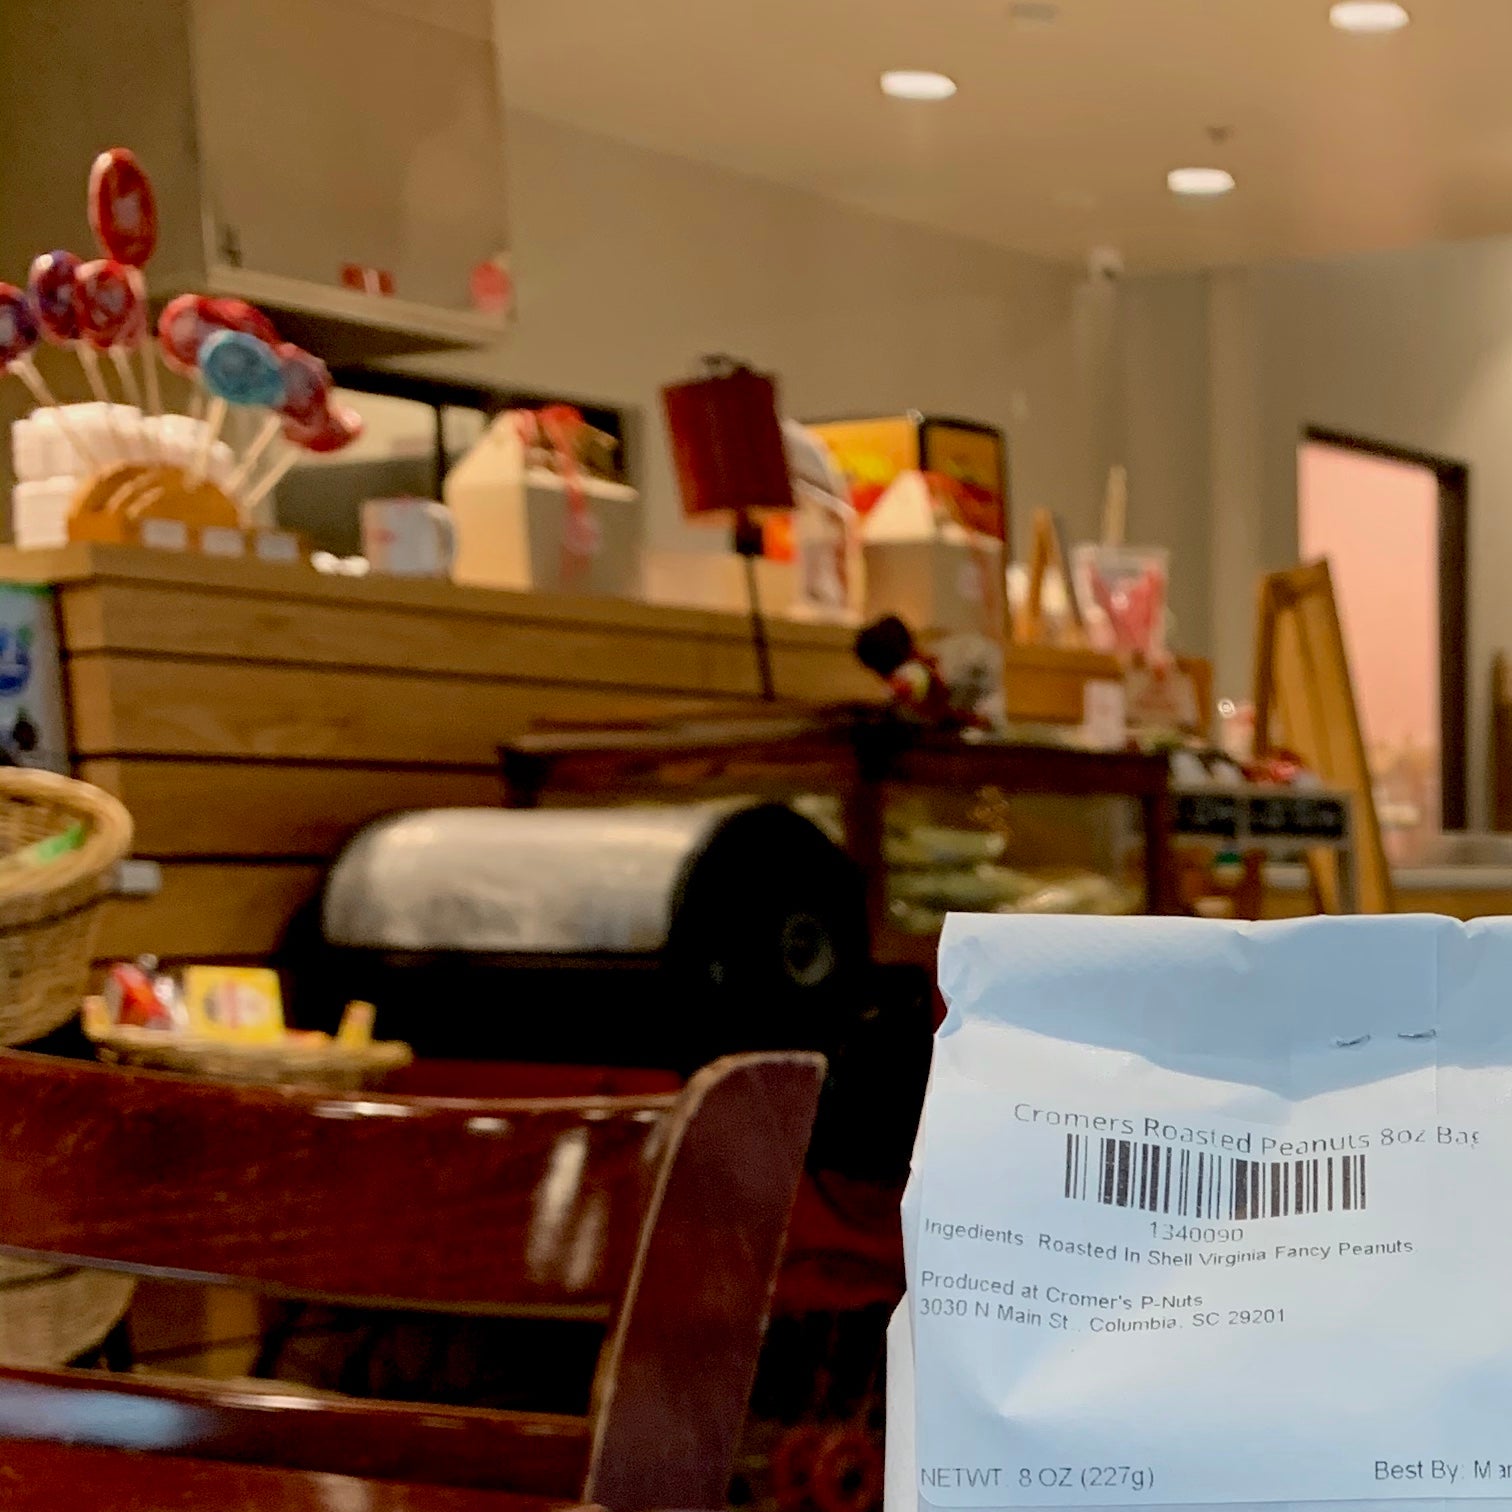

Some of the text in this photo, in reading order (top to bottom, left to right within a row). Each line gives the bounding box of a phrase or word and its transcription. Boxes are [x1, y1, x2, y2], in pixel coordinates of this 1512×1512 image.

[1014, 1103, 1134, 1135] Cromers
[1144, 1117, 1251, 1153] Roasted
[1262, 1132, 1370, 1156] Peanuts
[1381, 1128, 1426, 1146] 8oz
[1039, 1234, 1117, 1260] Roasted
[1125, 1248, 1140, 1264] In
[1147, 1250, 1193, 1267] Shell
[1199, 1250, 1266, 1268] Virginia
[1275, 1244, 1331, 1261] Fancy
[1339, 1239, 1413, 1257] Peanuts
[921, 1271, 1203, 1311] Produced at Cromer's P-Nuts
[920, 1298, 968, 1317] 3030
[975, 1301, 989, 1317] N
[997, 1304, 1041, 1327] Main
[1192, 1312, 1220, 1328] SC
[1228, 1308, 1285, 1326] 29201
[1018, 1467, 1032, 1488] 8
[1038, 1467, 1073, 1488] OZ
[1081, 1466, 1154, 1492] (227g)
[1374, 1459, 1424, 1481] Best
